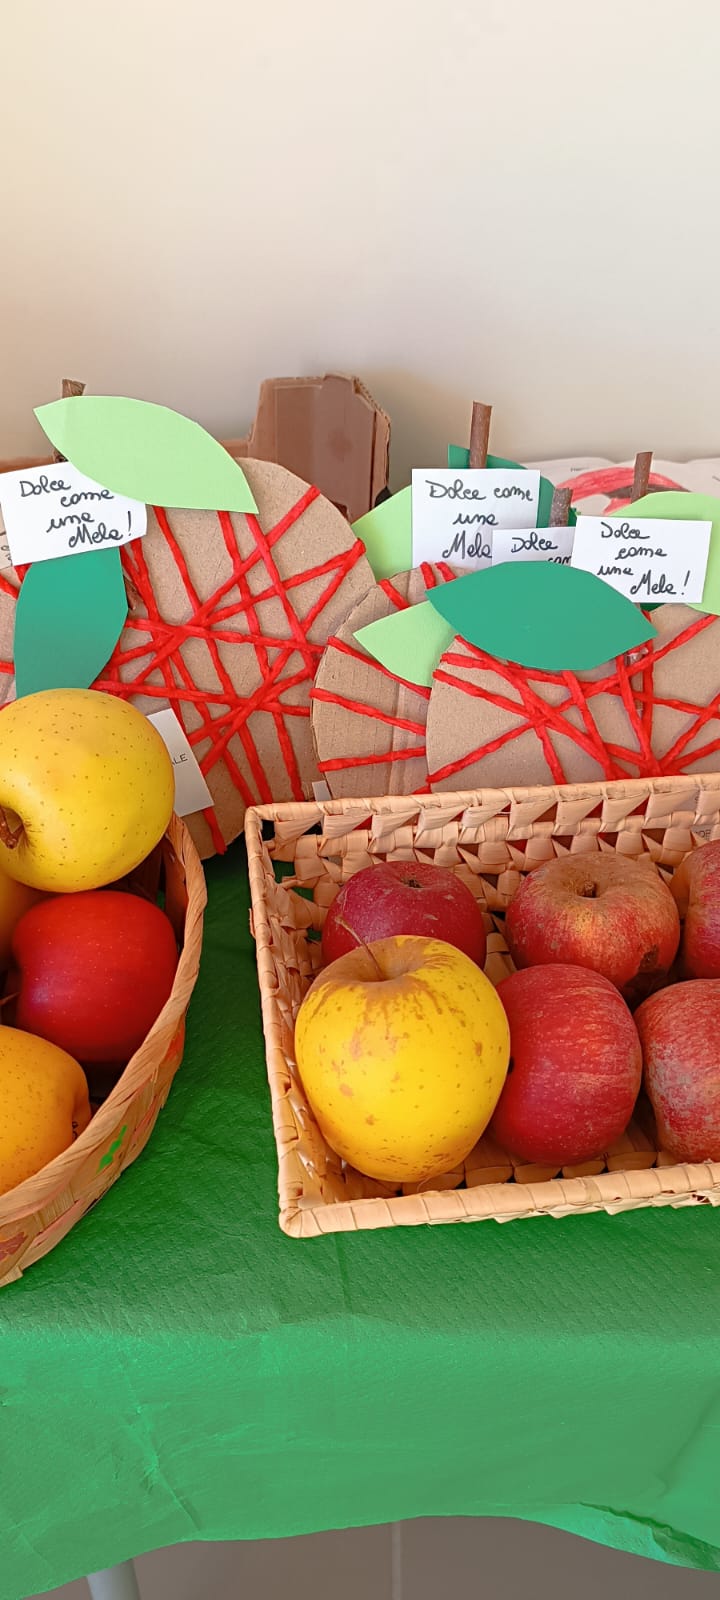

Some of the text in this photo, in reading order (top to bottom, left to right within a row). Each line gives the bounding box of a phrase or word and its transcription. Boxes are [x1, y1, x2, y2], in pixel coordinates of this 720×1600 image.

[19, 475, 72, 498] Dolce
[425, 479, 534, 502] Dolce come
[60, 489, 115, 508] come
[46, 512, 95, 533] una
[452, 513, 499, 526] una
[600, 521, 651, 540] Dolce
[511, 531, 559, 554] Dolce
[614, 546, 668, 560] come
